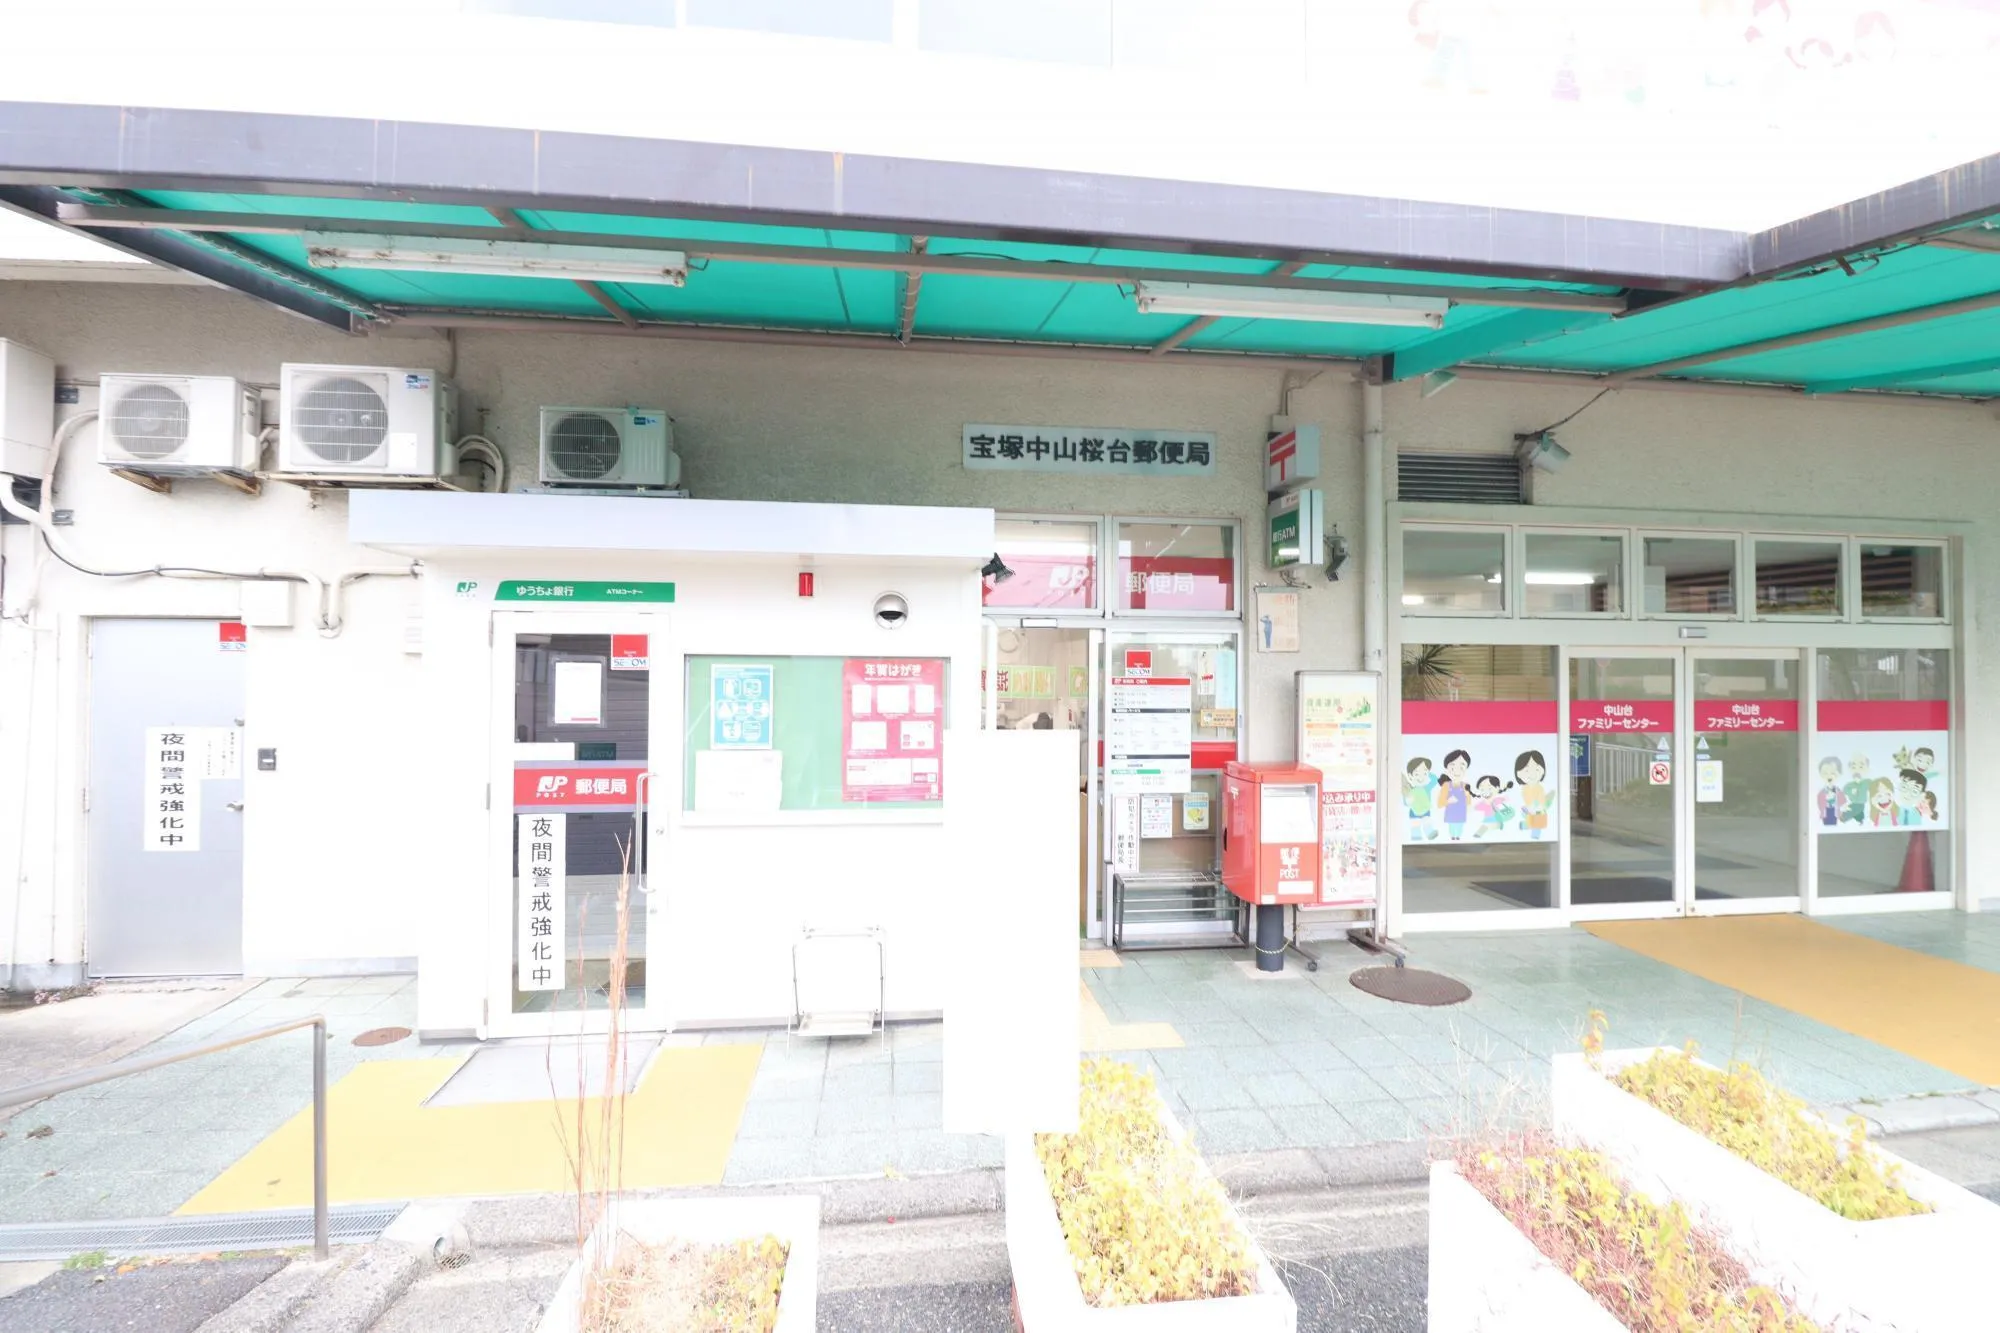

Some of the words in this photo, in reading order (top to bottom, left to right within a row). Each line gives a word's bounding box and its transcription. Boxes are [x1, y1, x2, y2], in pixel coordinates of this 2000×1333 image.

[969, 434, 1210, 466] 宝塚中山桜台郵便局
[457, 581, 478, 593] JP
[1125, 572, 1195, 595] 郵便局
[516, 585, 574, 597] ゆうちょ銀行
[613, 658, 647, 667] SEOM
[864, 663, 922, 677] 年賀はがき
[1603, 704, 1633, 716] 中山台
[1731, 703, 1760, 715] 中山台
[1577, 717, 1660, 729] ファミリーセンター
[1707, 717, 1785, 728] ファミリーセンター
[575, 779, 627, 794] 郵便局
[1322, 792, 1370, 803] 込み承り中
[1280, 868, 1300, 879] POST
[531, 817, 553, 986] 夜間警戒強化中
